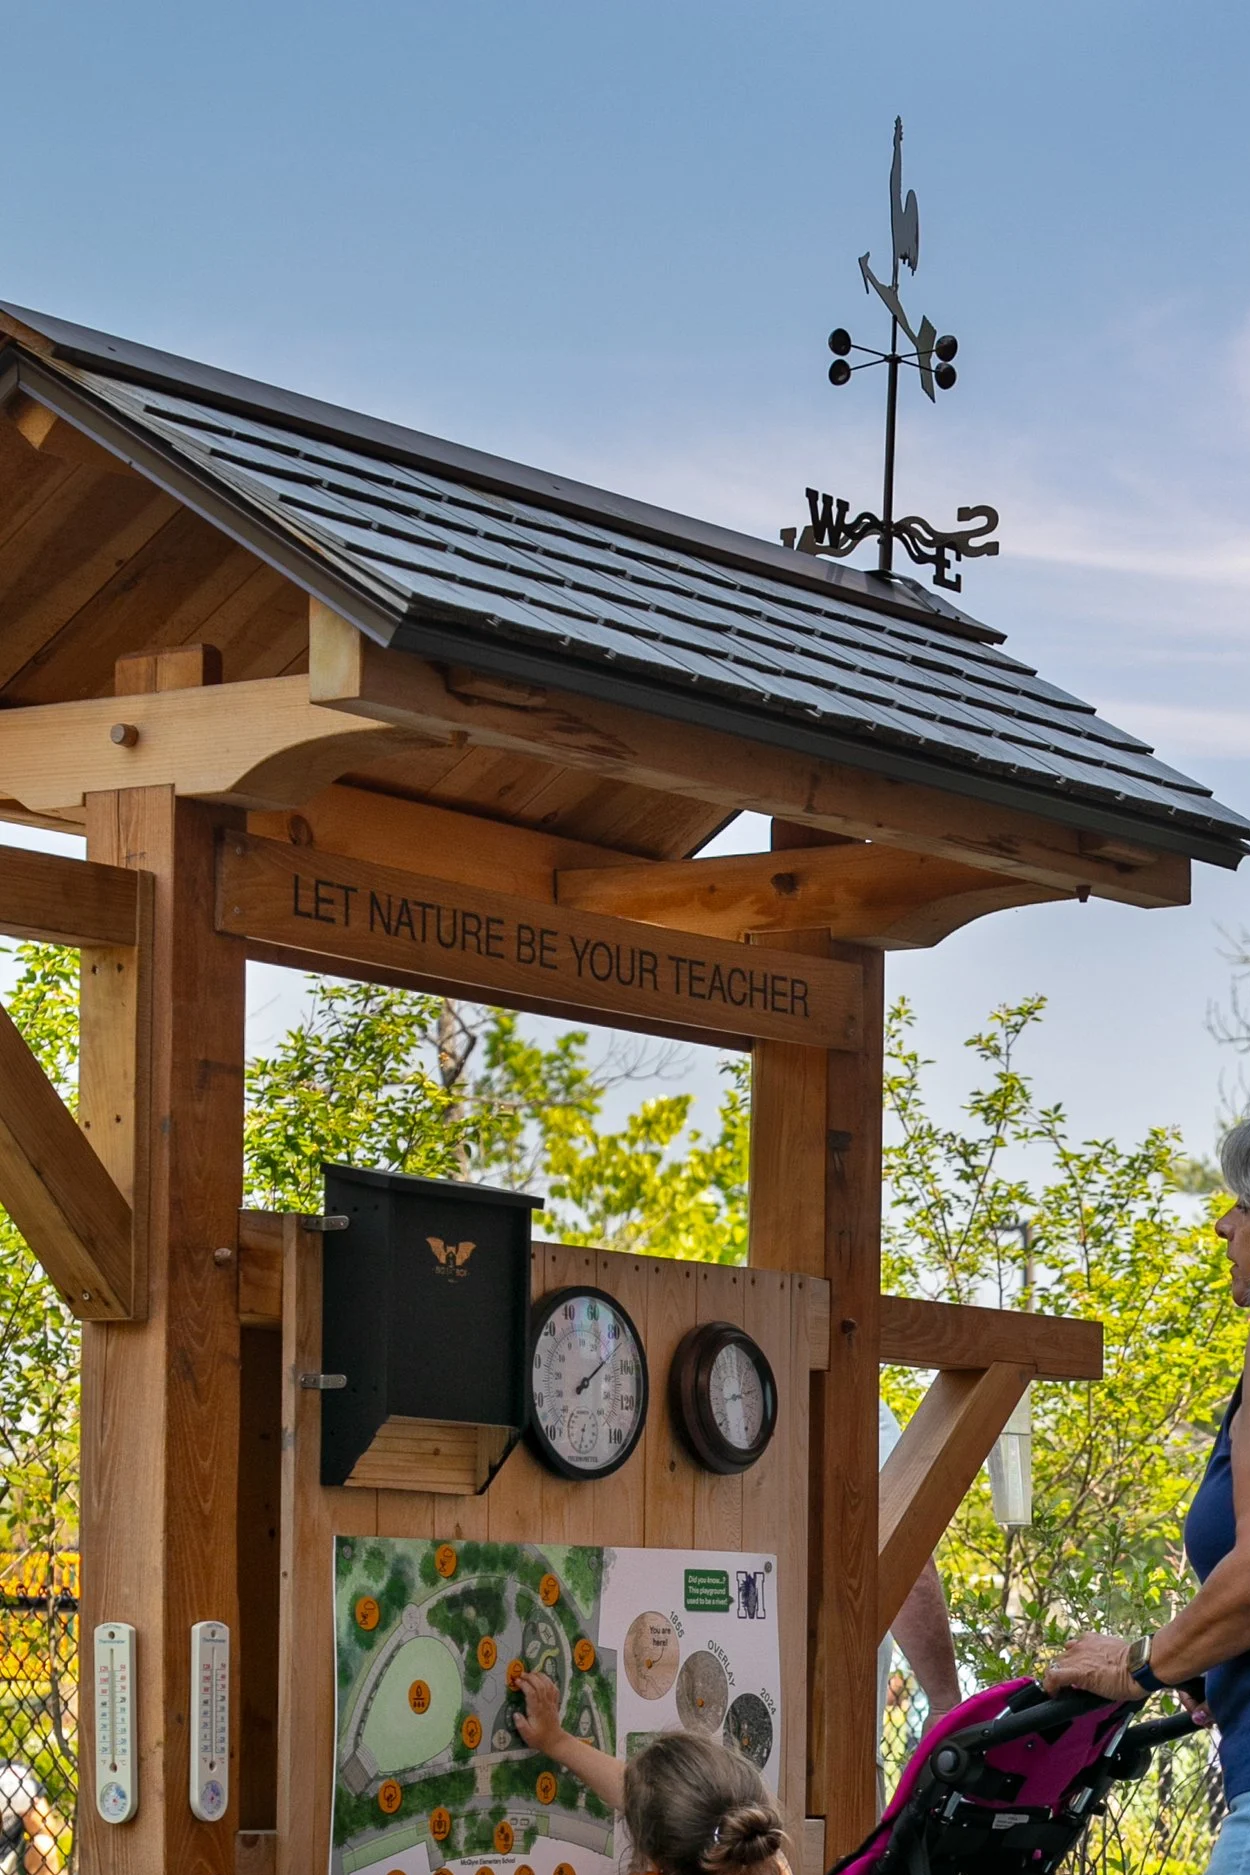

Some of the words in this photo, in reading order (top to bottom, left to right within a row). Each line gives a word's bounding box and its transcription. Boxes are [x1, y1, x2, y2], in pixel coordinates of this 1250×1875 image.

[806, 487, 849, 549] W
[933, 543, 962, 593] E
[294, 875, 357, 926] LET
[369, 892, 504, 959] NATURE
[518, 924, 558, 970] BE
[570, 935, 658, 991] YOUR
[668, 956, 809, 1018] TEACHER
[562, 1304, 575, 1320] 40
[587, 1304, 599, 1321] 60
[608, 1323, 619, 1340] 80
[535, 1354, 541, 1369] 0
[620, 1360, 634, 1375] 100
[620, 1395, 634, 1411] 120
[609, 1428, 622, 1444] 140
[688, 1576, 697, 1584] Did
[700, 1587, 726, 1596] playground
[650, 1626, 661, 1635] You
[653, 1638, 668, 1646] here!
[707, 1640, 736, 1687] OVERLAY
[760, 1688, 777, 1715] 2024
